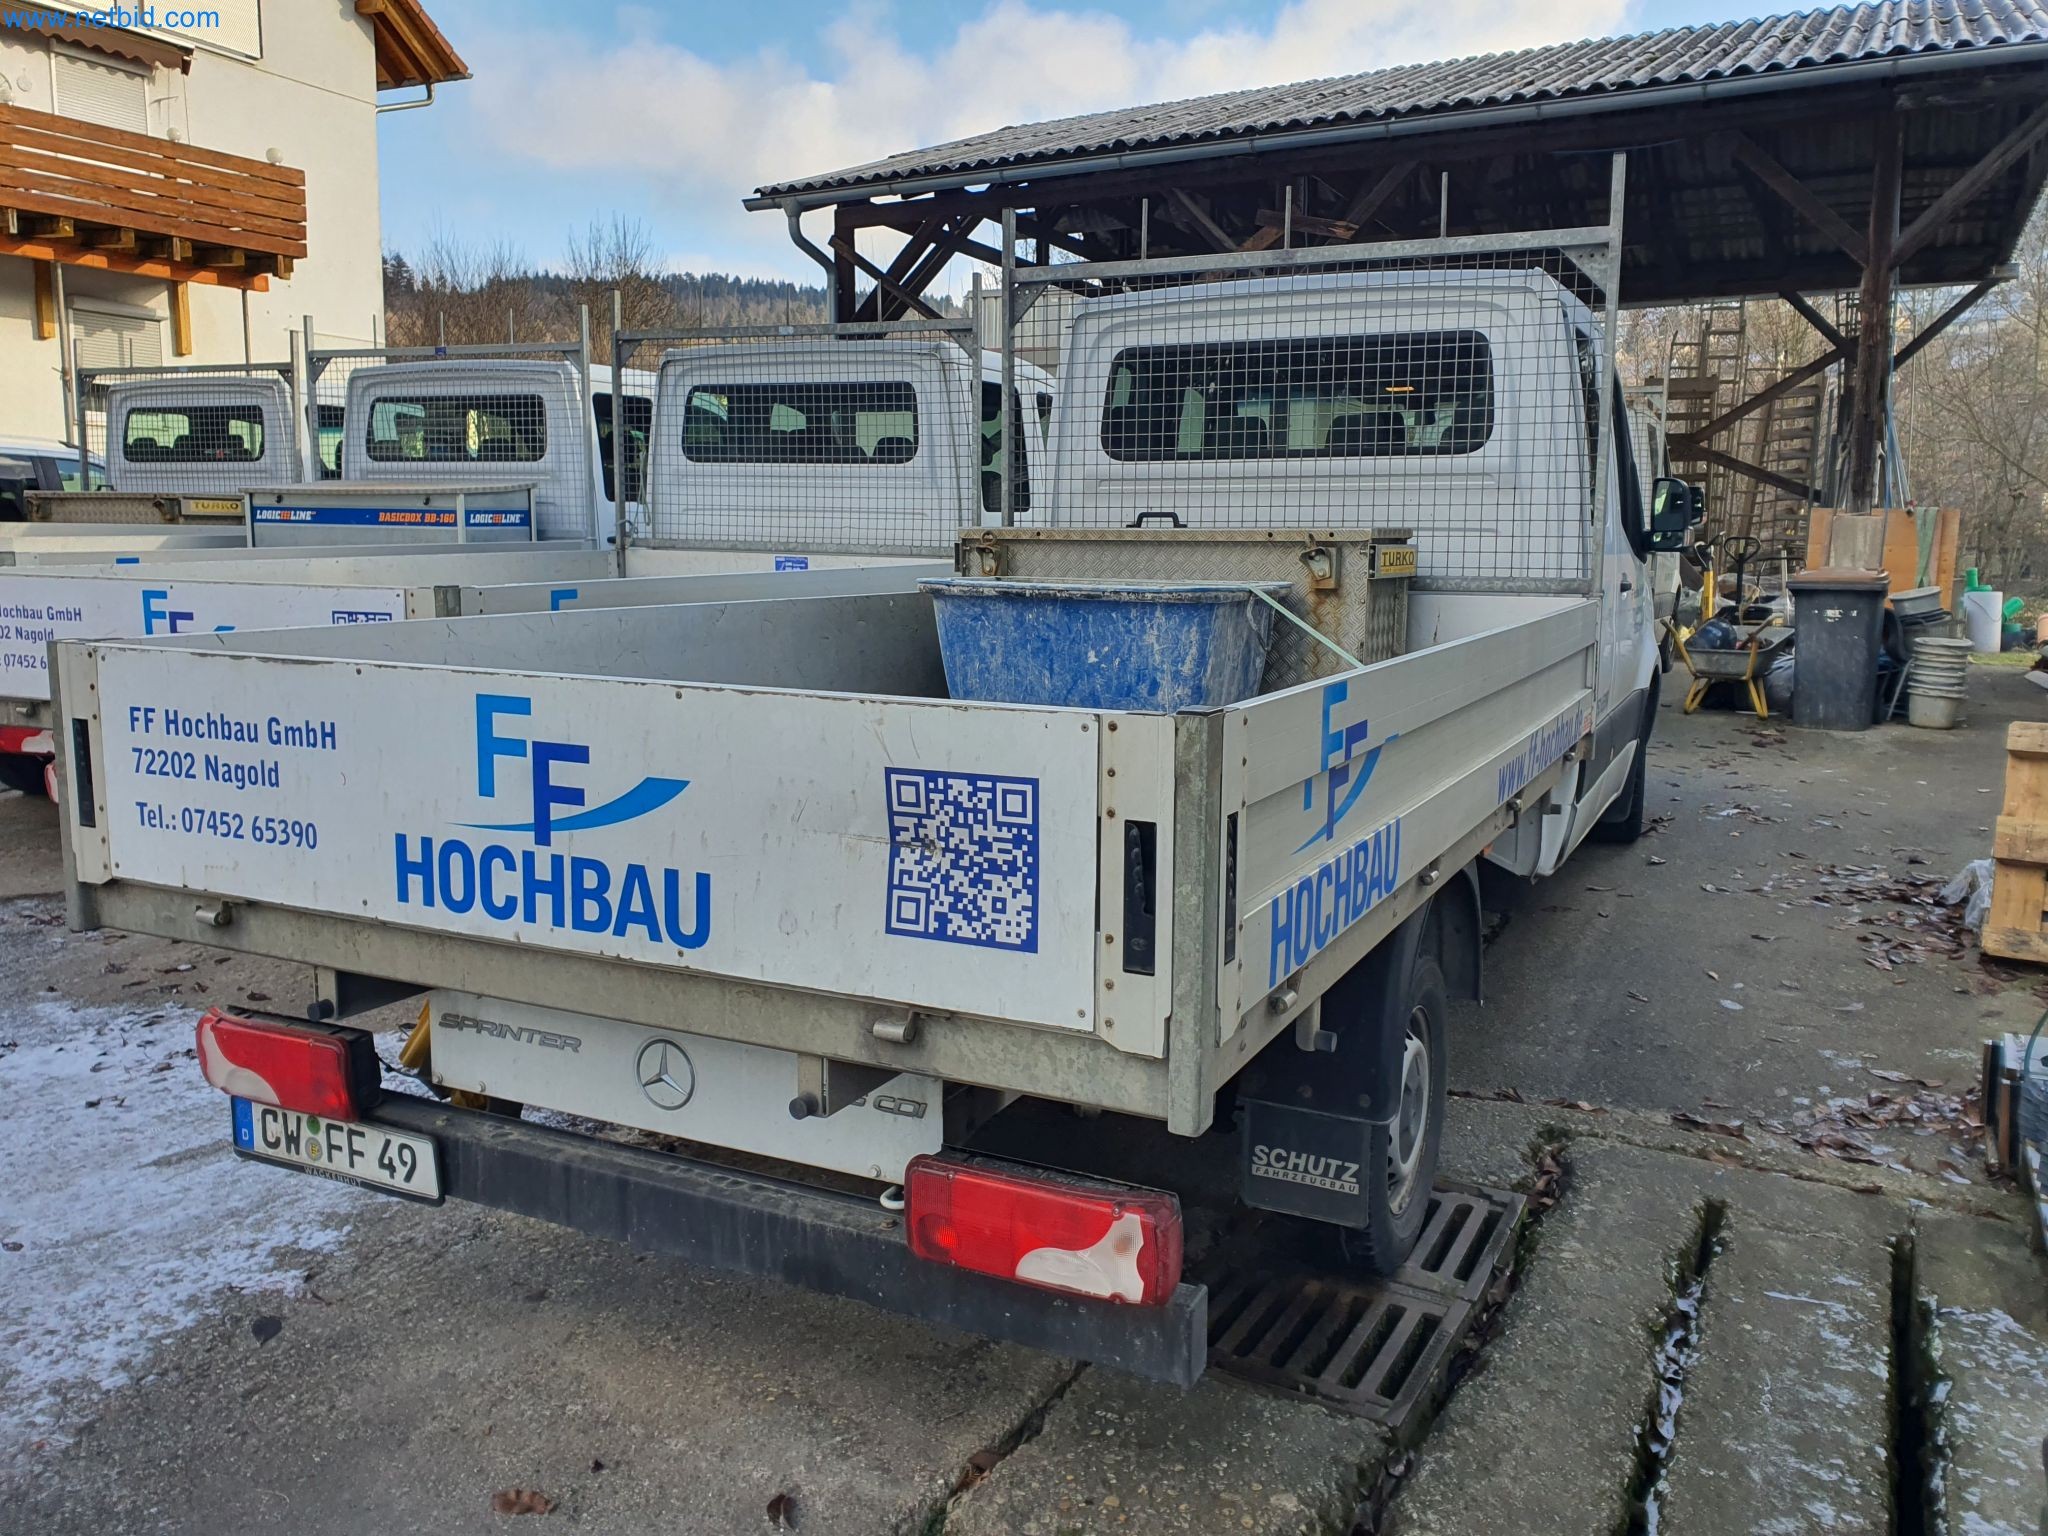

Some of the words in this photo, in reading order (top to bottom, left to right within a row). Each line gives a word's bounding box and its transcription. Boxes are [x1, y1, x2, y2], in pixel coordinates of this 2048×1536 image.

[1381, 551, 1415, 567] TURKO
[0, 604, 43, 620] ochbau
[46, 606, 82, 622] GmbH
[15, 626, 54, 644] Nagold
[4, 653, 37, 669] 07452
[129, 706, 156, 733] FF
[164, 709, 259, 743] Hochbau
[267, 716, 337, 750] GmbH
[131, 747, 197, 779] 72202
[204, 754, 280, 790] Nagold
[475, 693, 590, 847] FF
[1304, 680, 1369, 842] FF
[135, 801, 176, 831] Tel.:
[181, 807, 245, 839] 07452
[251, 816, 318, 850] 65390
[394, 832, 711, 950] HOCHBAU
[1269, 816, 1400, 989] HOCHBAU
[439, 1012, 582, 1053] SPRINTER
[873, 1095, 928, 1119] CDI
[241, 1127, 249, 1141] D
[260, 1107, 301, 1156] CW
[325, 1123, 366, 1169] FF
[377, 1133, 417, 1183] 49
[1252, 1144, 1360, 1183] SCHUTZ
[1255, 1166, 1356, 1193] FAHRZEUGBAU
